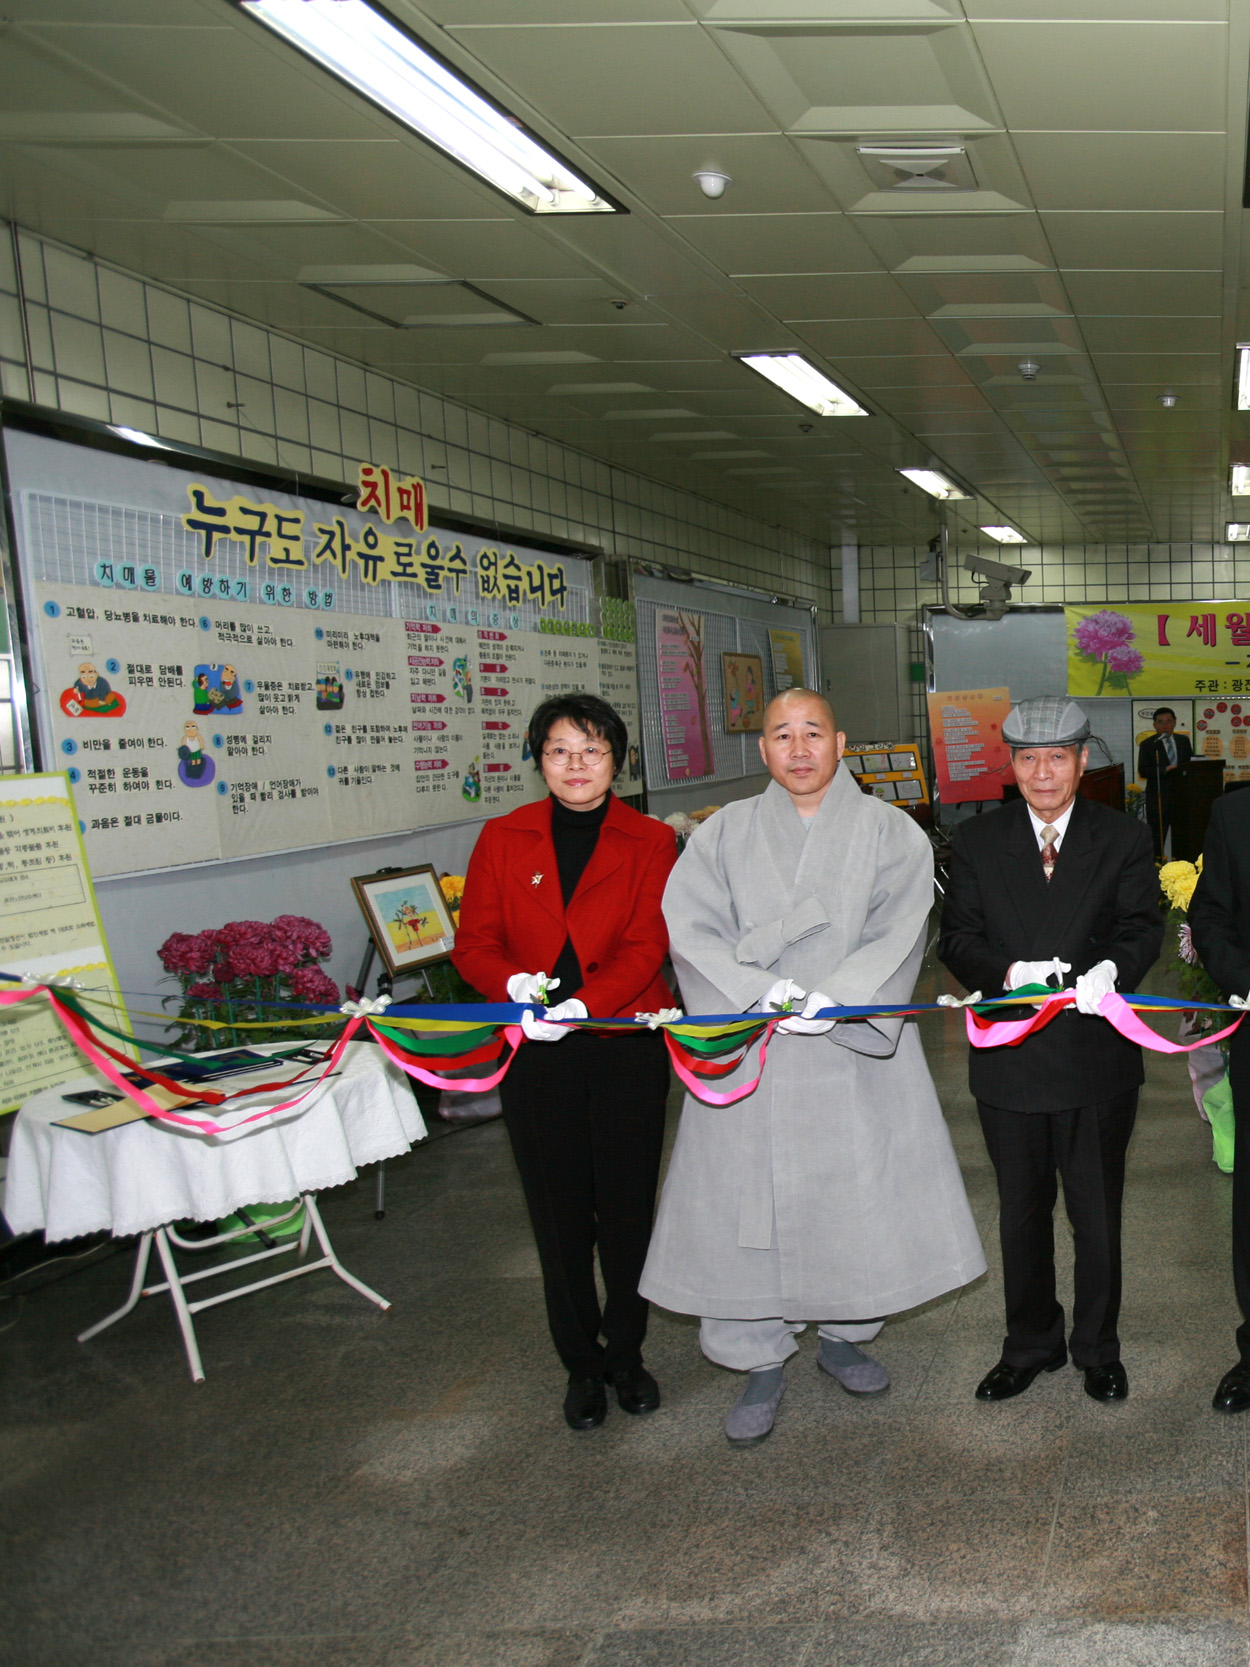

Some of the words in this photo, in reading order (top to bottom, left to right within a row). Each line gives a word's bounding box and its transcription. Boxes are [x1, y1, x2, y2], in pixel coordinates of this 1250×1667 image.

[361, 467, 424, 531] 치매
[186, 489, 305, 566] 누구도
[477, 551, 568, 608] 없습니다
[100, 563, 157, 587] 치매를
[181, 573, 247, 598] 예방하기
[265, 584, 291, 603] 위한
[307, 590, 333, 608] 방법
[66, 606, 99, 619] 고혈압,
[104, 609, 140, 623] 당뇨병을
[143, 613, 176, 626] 치료해야
[179, 616, 198, 628] 한다.
[215, 620, 236, 632] 머리를
[239, 622, 254, 633] 많이
[326, 630, 349, 640] 미리미리
[353, 632, 380, 642] 노후대책을
[126, 663, 153, 675] 절대로
[158, 664, 184, 676] 담배를
[128, 676, 154, 687] 피우면
[158, 676, 186, 688] 안된다.
[83, 739, 111, 751] 비만을
[147, 737, 168, 749] 한다.
[87, 768, 115, 780] 적절한
[122, 766, 149, 779] 운동을
[89, 781, 117, 794] 꾸준히
[123, 780, 150, 792] 하여야
[230, 781, 258, 792] 기억장애
[91, 816, 120, 830] 과음은
[123, 814, 142, 827] 절대
[145, 811, 184, 824] 금물이다.
